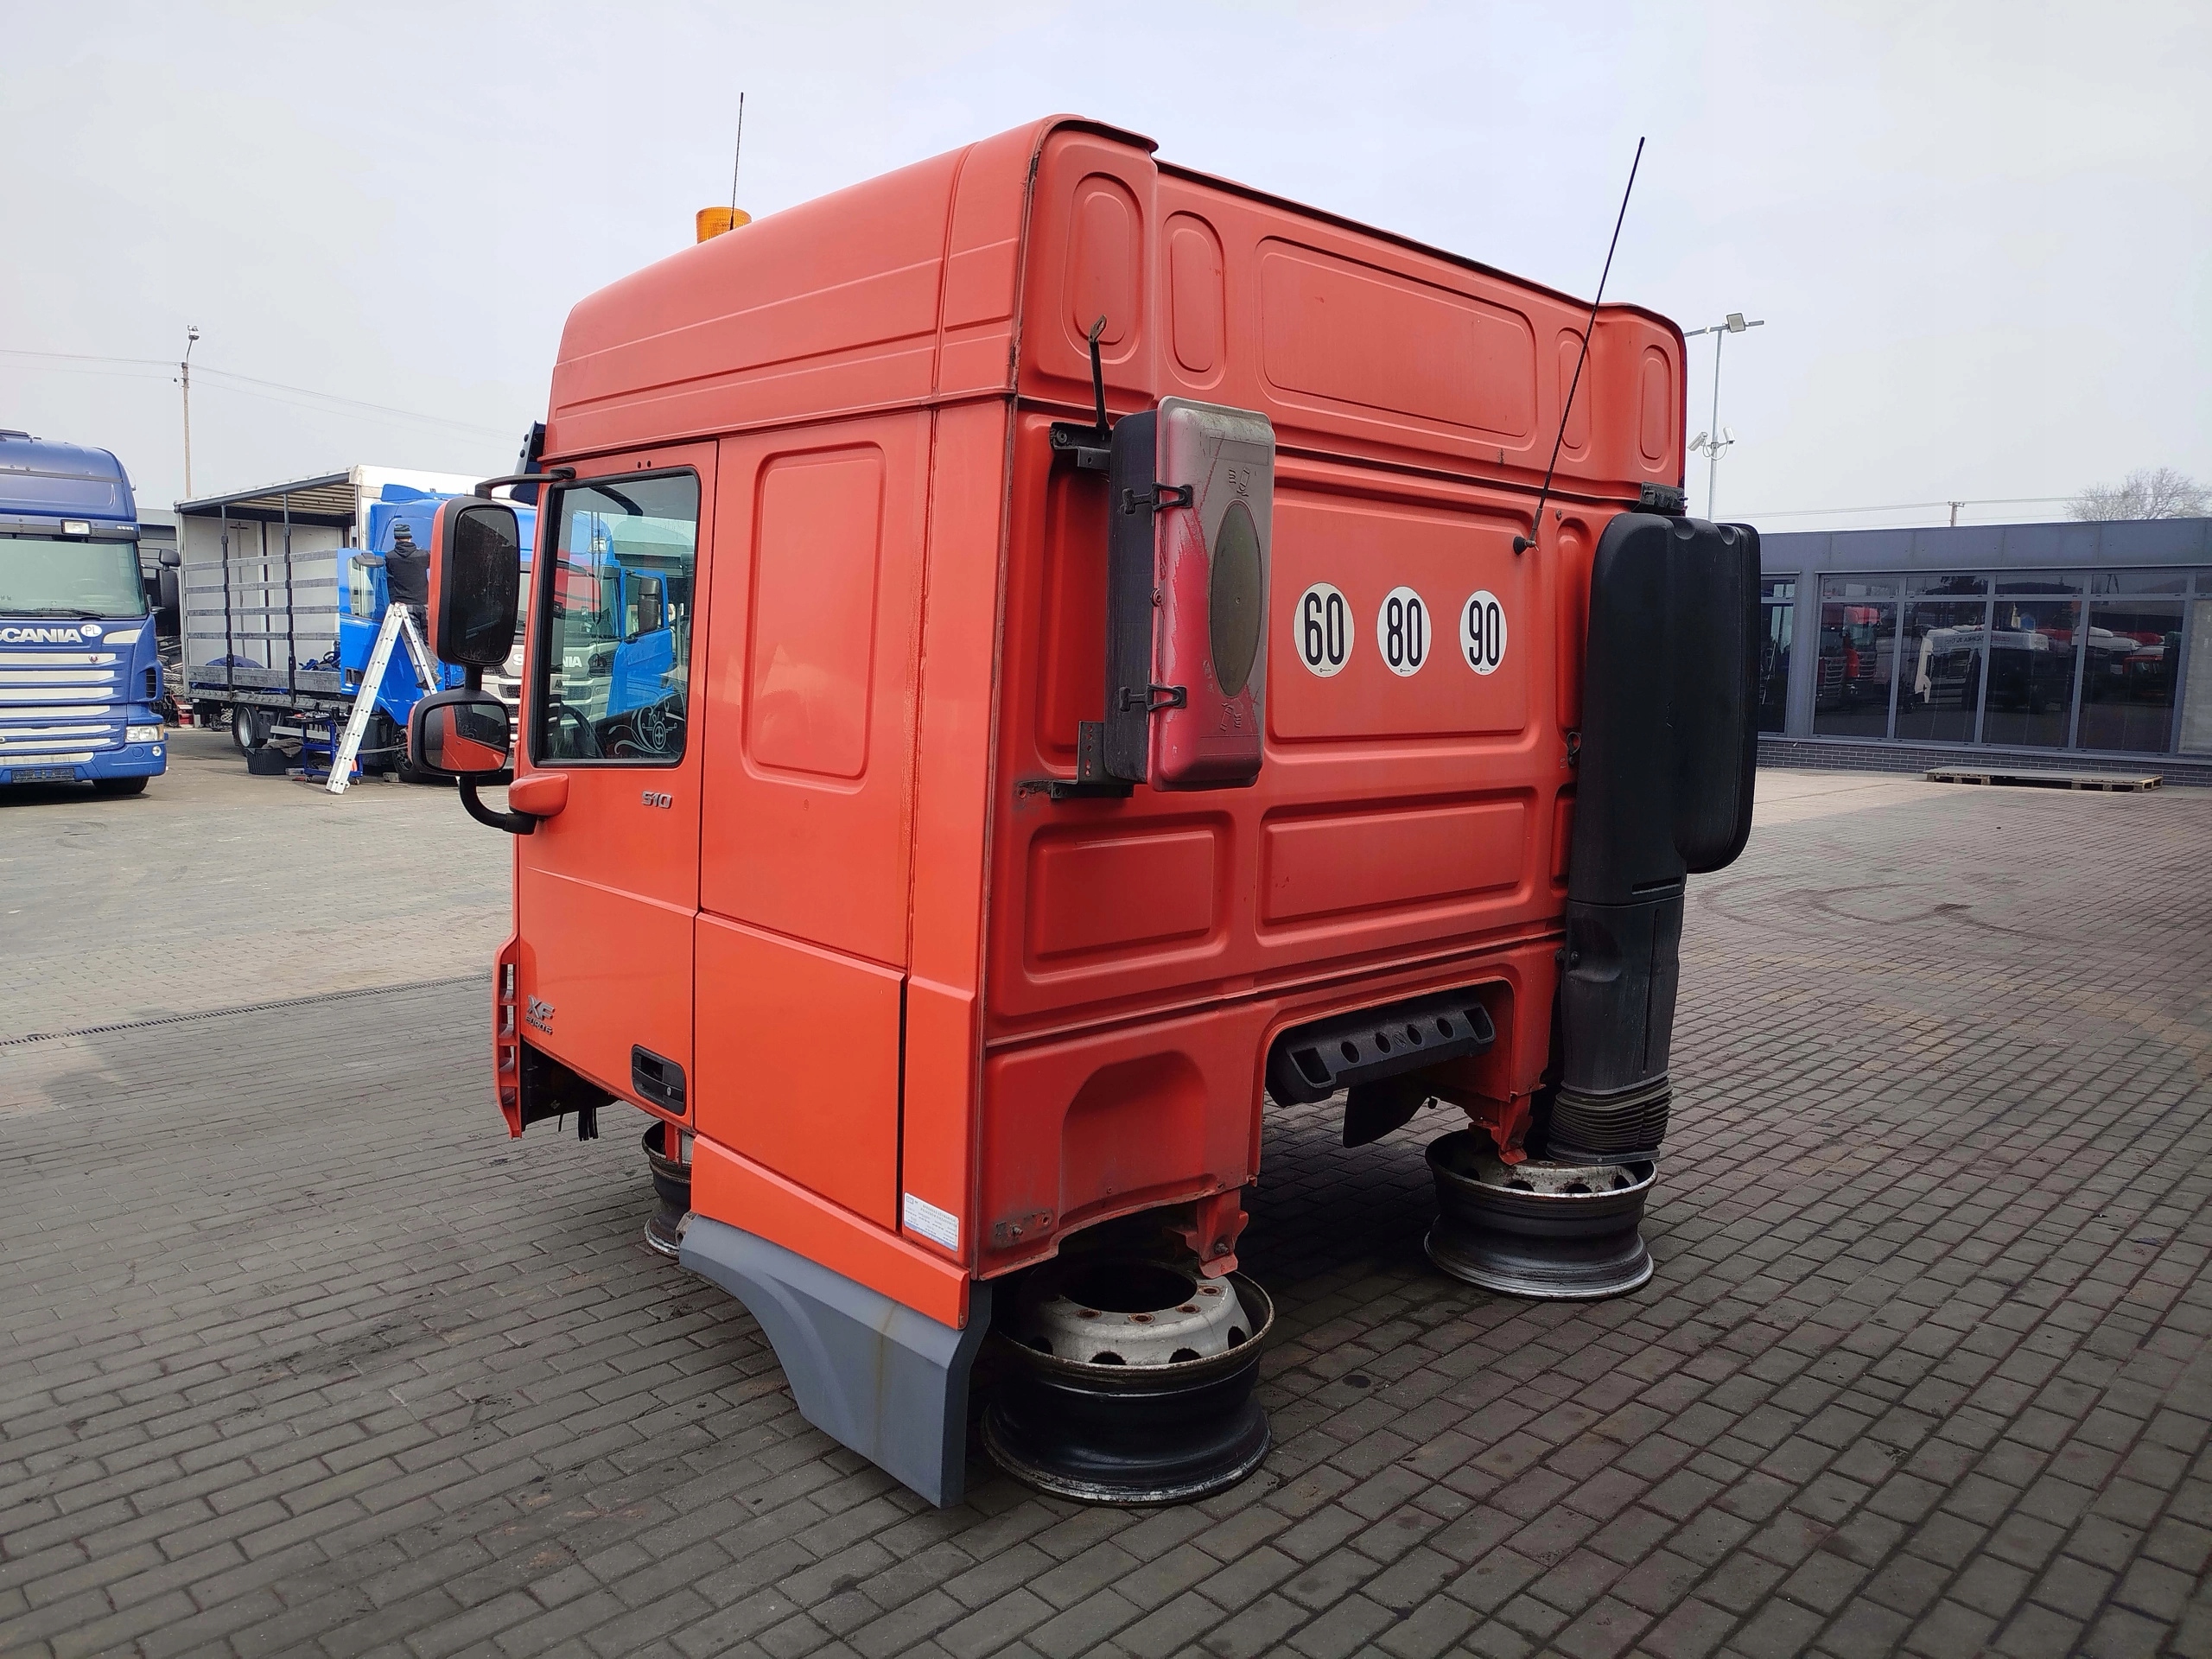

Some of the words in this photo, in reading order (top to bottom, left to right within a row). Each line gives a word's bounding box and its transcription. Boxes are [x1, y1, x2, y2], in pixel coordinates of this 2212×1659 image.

[0, 627, 83, 643] CANIA
[85, 626, 99, 635] PL
[1304, 592, 1344, 666] 60
[1388, 597, 1422, 667] 80
[1469, 601, 1500, 666] 90
[641, 791, 673, 809] 510
[527, 995, 556, 1020] XF
